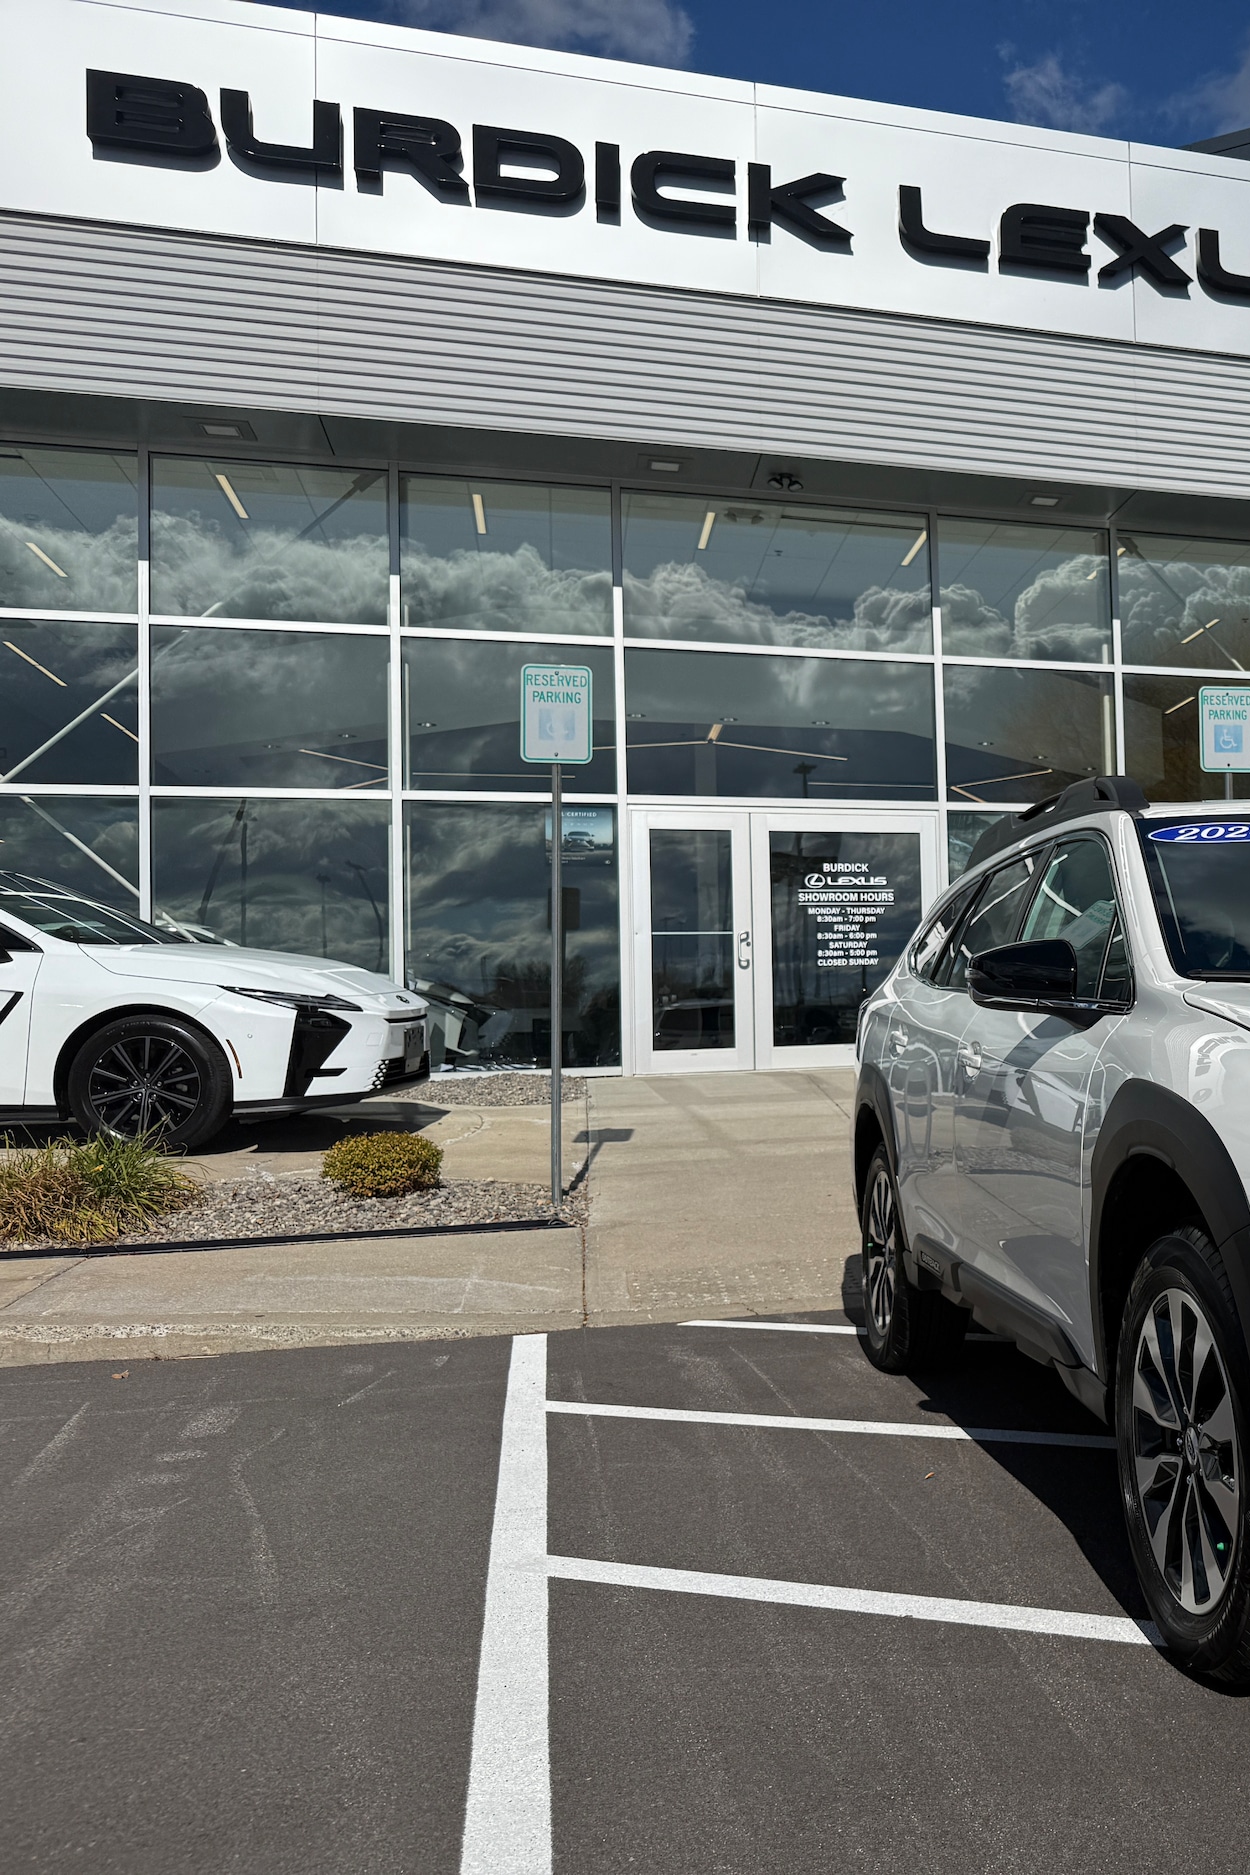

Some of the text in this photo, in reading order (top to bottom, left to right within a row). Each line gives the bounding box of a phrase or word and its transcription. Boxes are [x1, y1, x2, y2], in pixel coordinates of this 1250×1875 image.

[85, 67, 855, 244] BURDICK
[525, 674, 588, 688] RESERVED
[532, 691, 582, 704] PARKING
[1208, 709, 1248, 721] PARKING
[822, 863, 869, 873] BURDICK
[827, 876, 888, 886] LEXUS
[798, 892, 894, 902] SHOWROOM HOURS
[807, 907, 841, 915] MONDAY
[846, 907, 885, 915] THURSDAY
[816, 915, 843, 923] 8:30am
[849, 915, 864, 923] 7:00
[834, 924, 861, 932] FRIDAY
[816, 932, 844, 940] 8:30am
[829, 941, 868, 949] SATURDAY
[850, 949, 865, 957] 5:00
[817, 958, 879, 967] CLOSED SUNDAY
